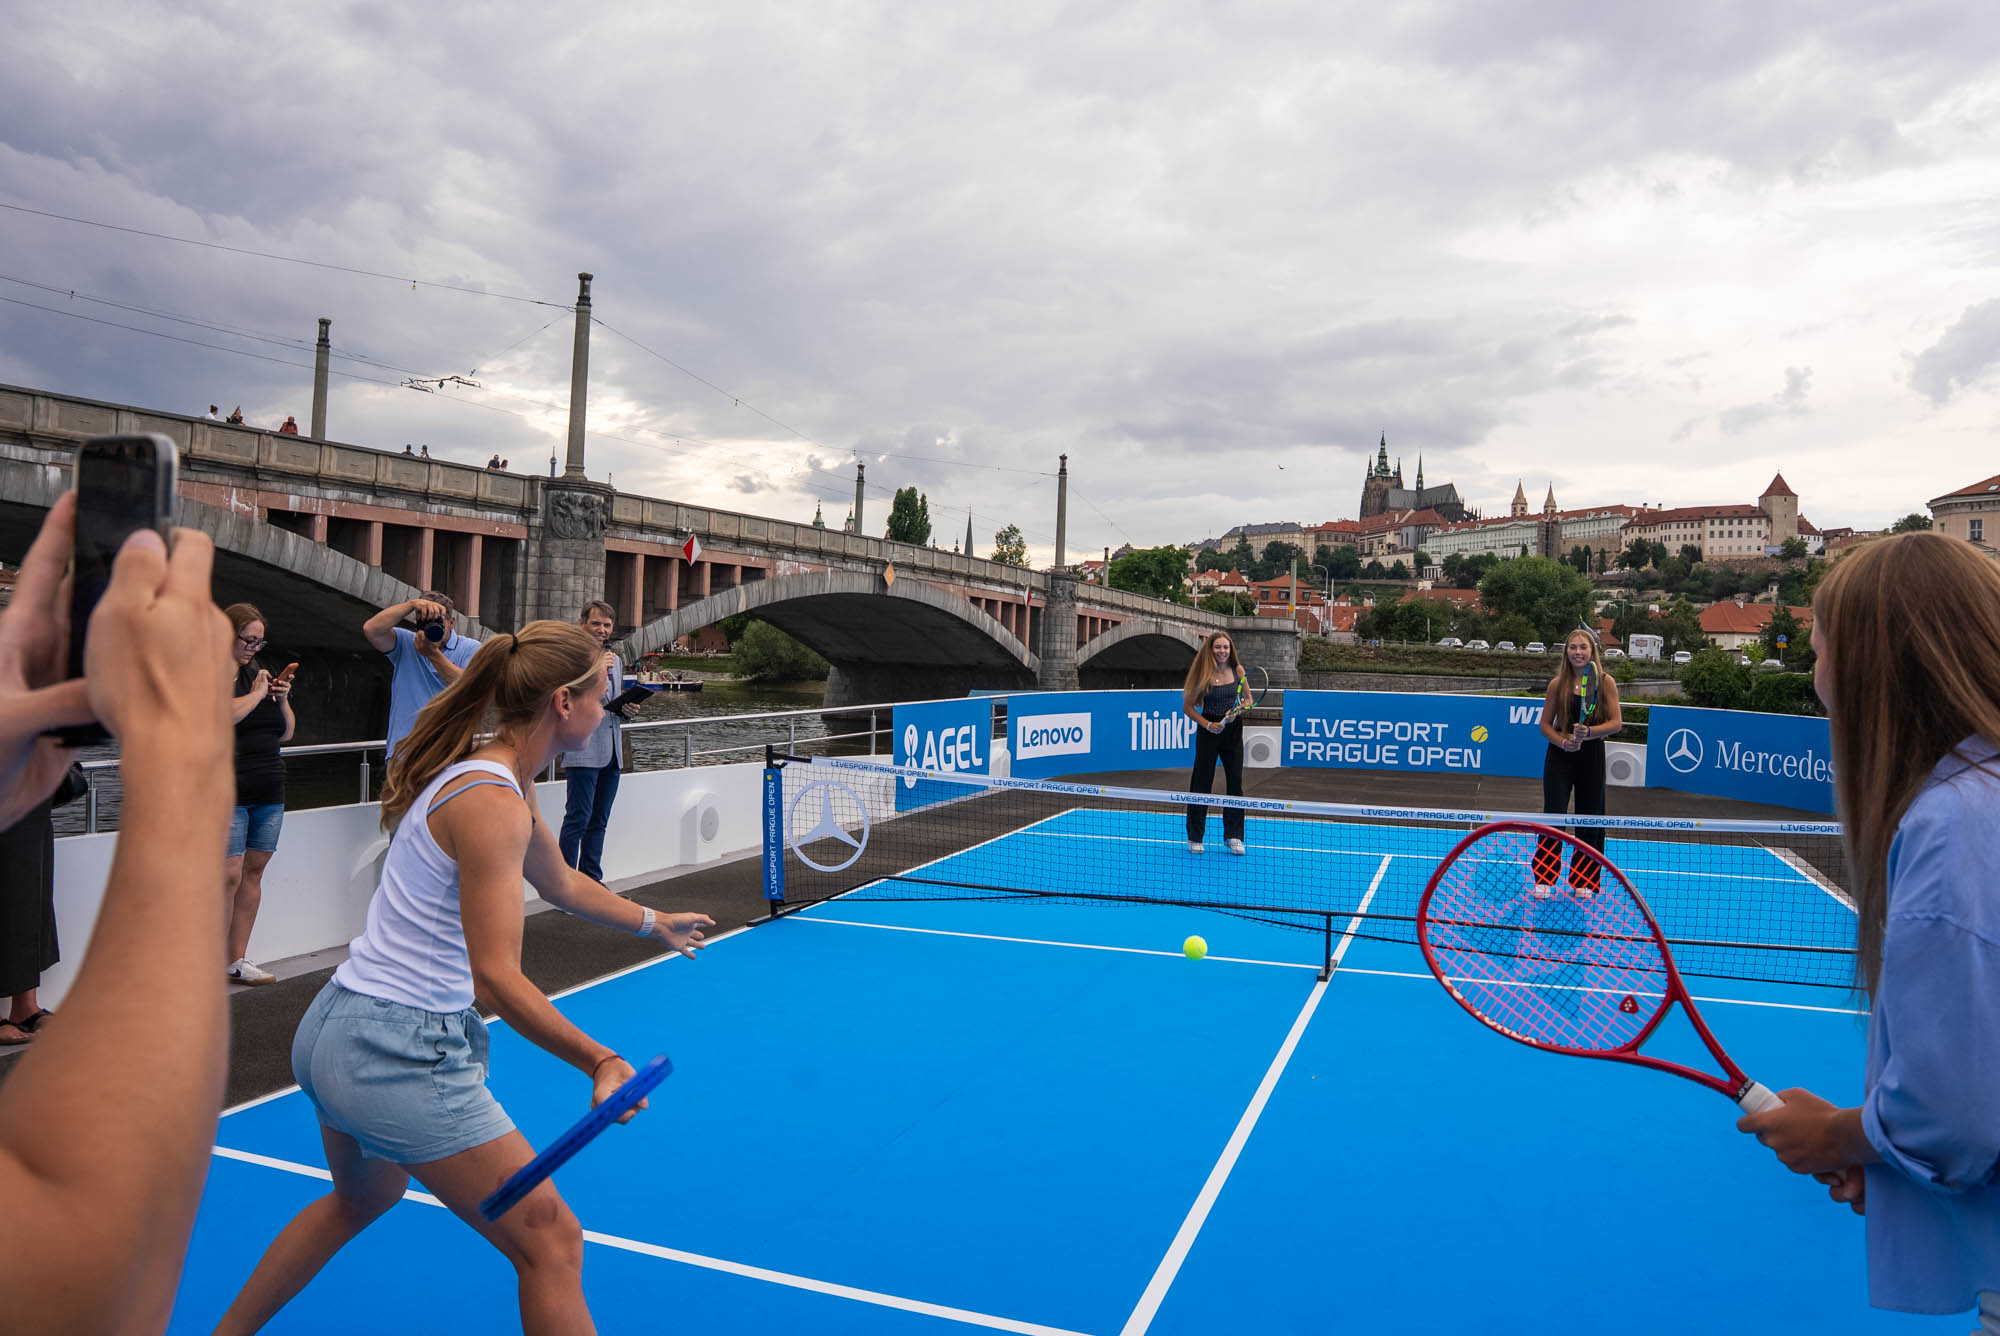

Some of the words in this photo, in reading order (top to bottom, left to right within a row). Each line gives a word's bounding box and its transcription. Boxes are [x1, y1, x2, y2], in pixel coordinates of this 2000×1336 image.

[1509, 705, 1544, 725] WT
[1022, 725, 1084, 748] Lenovo
[1127, 710, 1198, 751] ThinkP
[1290, 717, 1449, 743] LIVESPORT
[921, 724, 983, 771] AGEL
[1289, 741, 1399, 765] PRAGUE
[1408, 746, 1482, 769] OPEN
[830, 760, 873, 772] LIVESPORT
[874, 765, 905, 776] PRAGUE
[906, 769, 928, 778] OPEN
[1714, 740, 1837, 784] Mercedes
[993, 778, 1039, 790] LIVESPORT
[1041, 783, 1075, 793] PRAGUE
[1076, 786, 1099, 795] OPEN
[1170, 793, 1220, 805] LIVESPORT
[1222, 798, 1259, 808] PRAGUE
[1260, 801, 1285, 810] OPEN
[1361, 808, 1415, 818] LIVESPORT
[1417, 811, 1455, 820] PRAGUE
[1457, 813, 1484, 821] OPEN
[1564, 817, 1621, 827] LIVESPORT
[1623, 819, 1665, 828] PRAGUE
[1666, 820, 1694, 829] OPEN
[770, 845, 778, 895] LIVESPORT
